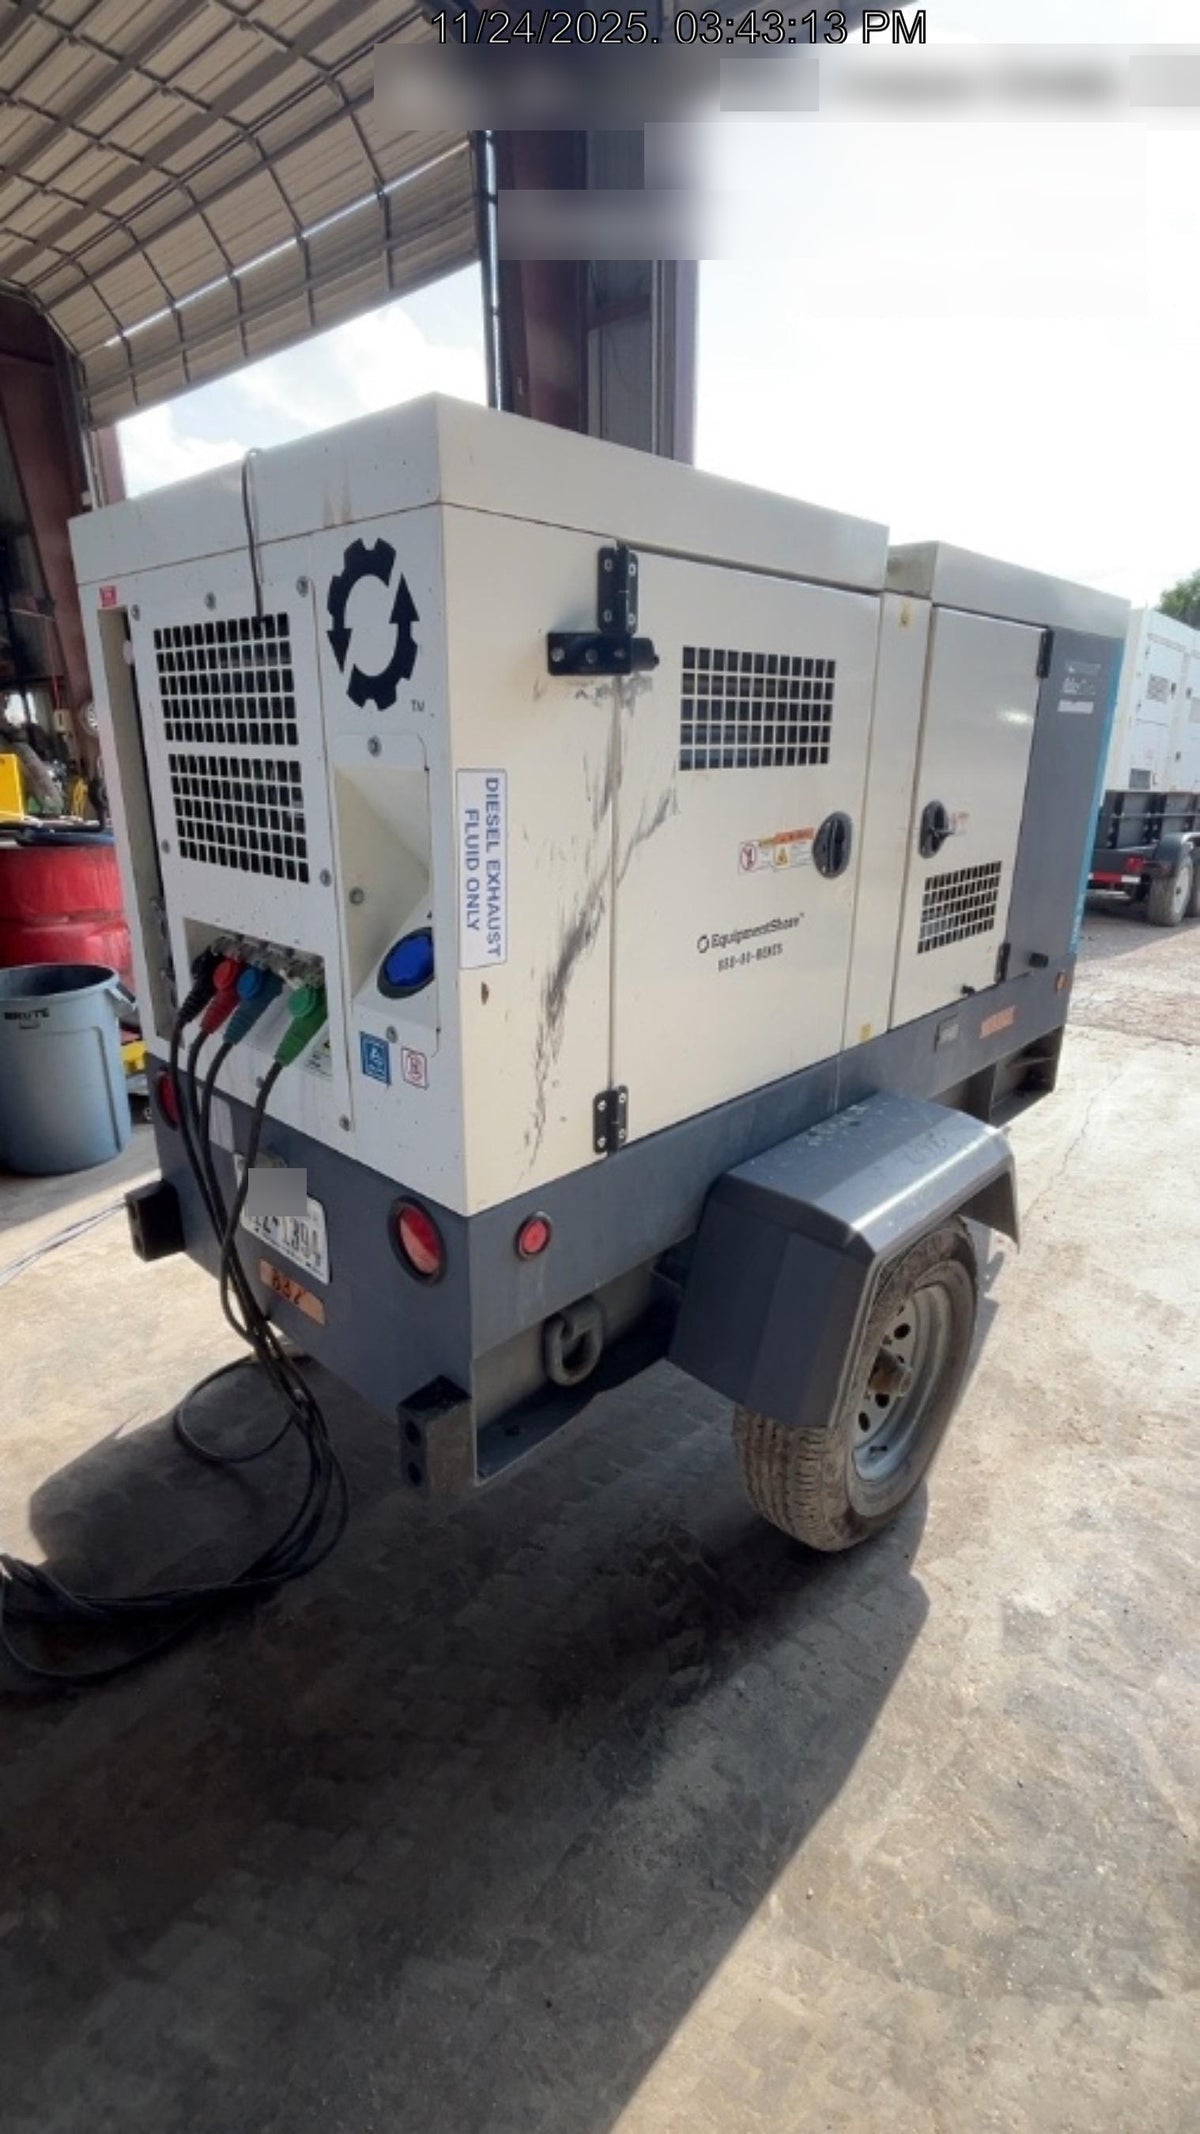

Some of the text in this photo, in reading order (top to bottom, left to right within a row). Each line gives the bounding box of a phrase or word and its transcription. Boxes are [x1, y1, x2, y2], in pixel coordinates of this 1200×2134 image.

[464, 808, 480, 932] FLUID ONLY
[485, 778, 501, 957] DIESEL EXHAUST
